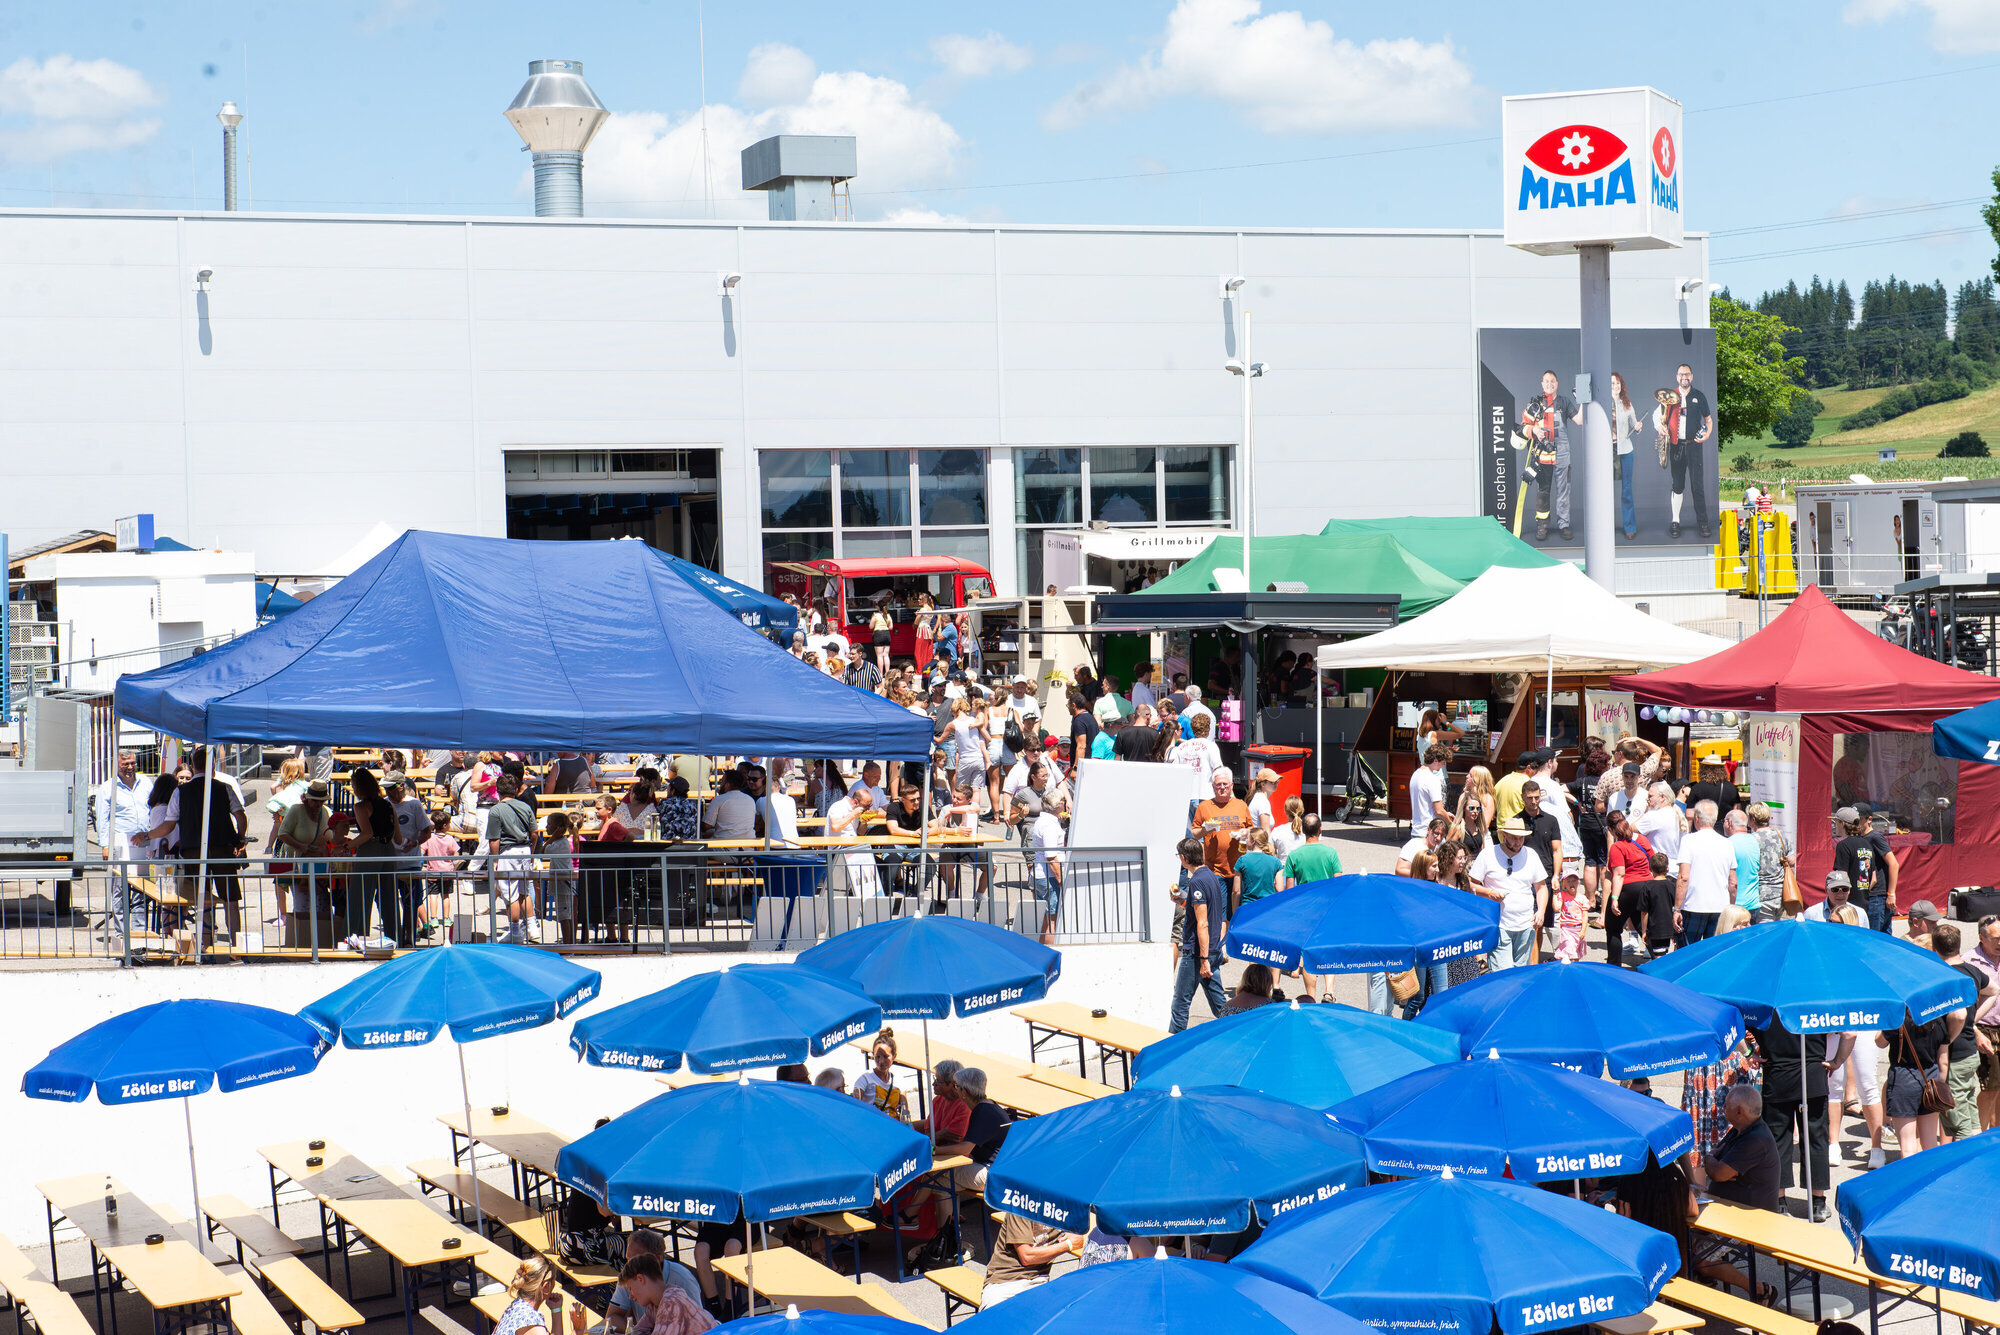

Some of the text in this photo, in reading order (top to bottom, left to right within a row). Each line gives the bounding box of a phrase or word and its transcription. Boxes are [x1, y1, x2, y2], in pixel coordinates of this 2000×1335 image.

[1518, 157, 1636, 211] MAHA
[1651, 159, 1679, 214] MAHA
[1492, 406, 1505, 454] TYPEN
[1493, 457, 1506, 510] suchen
[1048, 540, 1076, 551] Grillmobil
[1131, 537, 1204, 547] Grillmobil
[1756, 722, 1793, 747] Waffelz
[1241, 943, 1288, 964] Zötler Bier
[1432, 939, 1483, 960] Zötler Bier
[964, 987, 1023, 1011] Zötler Bier
[1800, 1010, 1880, 1029] Zötler Bier
[363, 1029, 428, 1045] Zötler Bier
[822, 1021, 865, 1050] Zötler Bier
[601, 1050, 665, 1069] Zötler Bier
[121, 1078, 196, 1098] Zötler Bier
[1378, 1158, 1415, 1170] natürlich,
[1467, 1165, 1488, 1175] frisch
[1536, 1152, 1622, 1173] Zötler Bier
[632, 1195, 716, 1216] Zötler Bier
[1001, 1189, 1069, 1222] Zötler Bier
[1272, 1183, 1347, 1217] Zötler Bier
[1890, 1253, 1982, 1289] Zötler Bier
[1522, 1294, 1614, 1326] Zötler Bier
[1439, 1319, 1460, 1330] frisch
